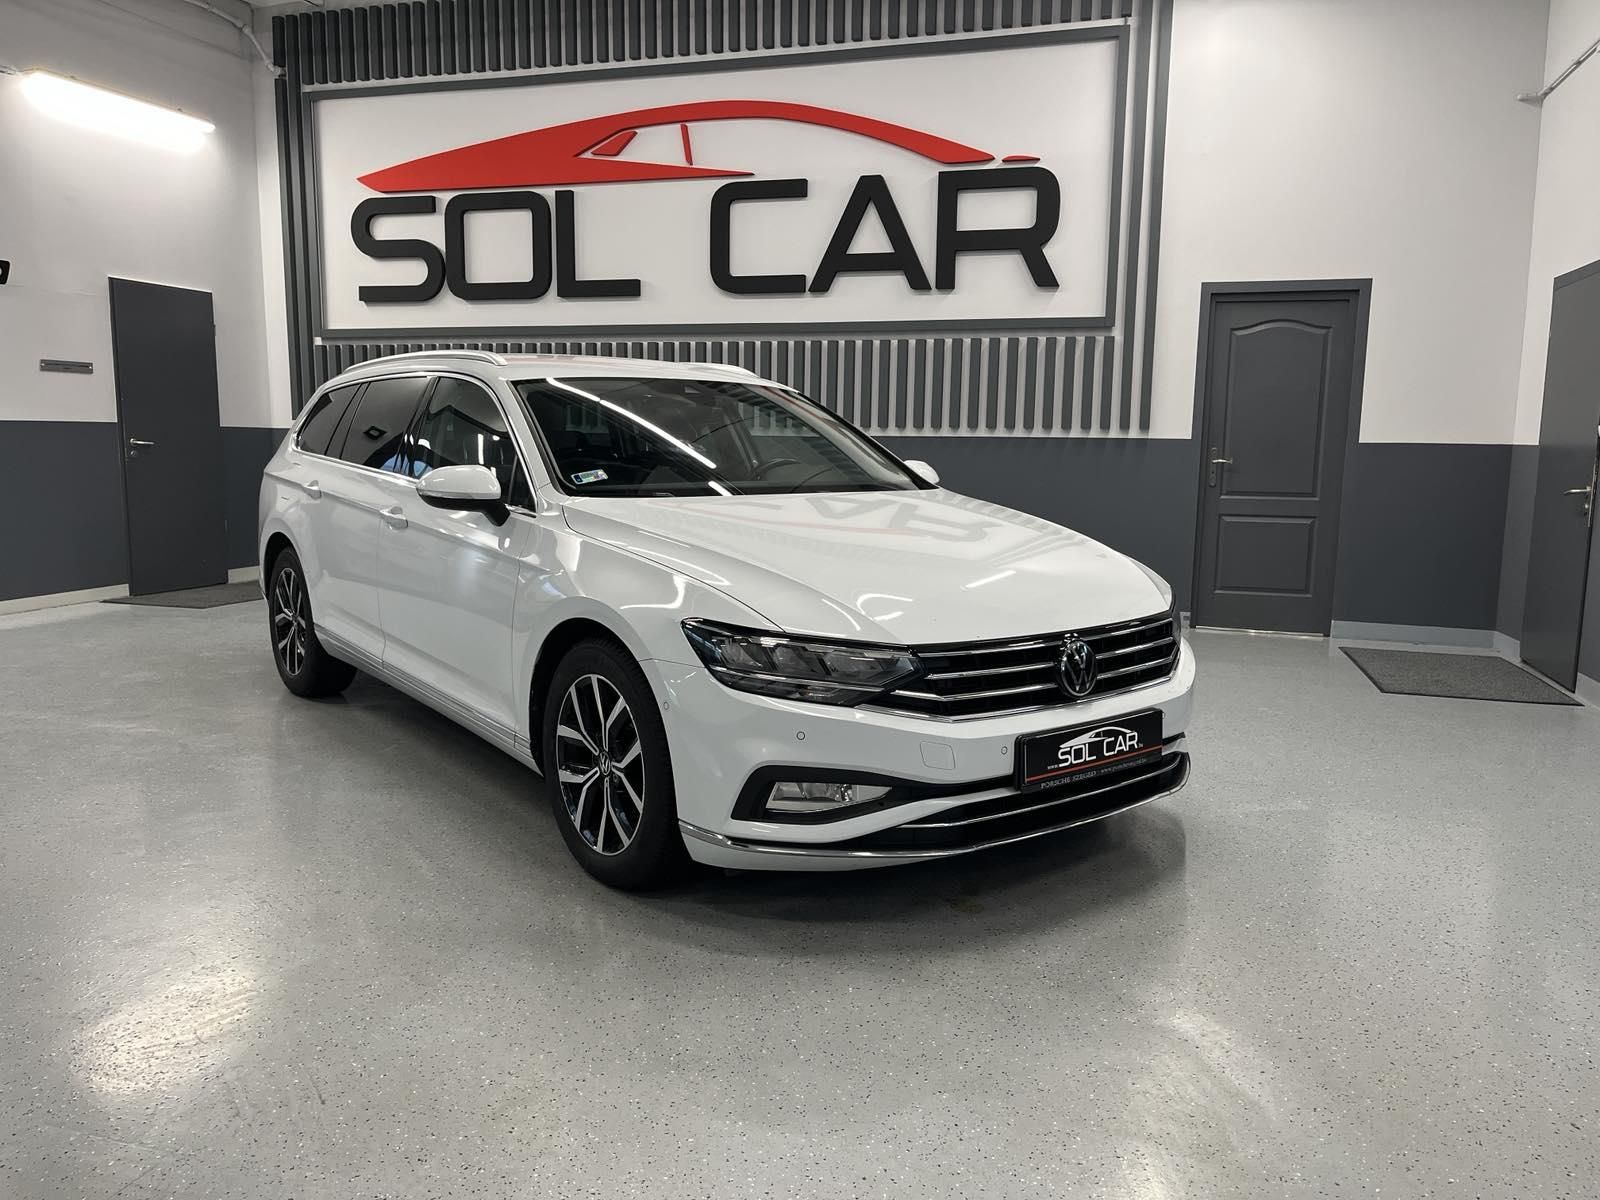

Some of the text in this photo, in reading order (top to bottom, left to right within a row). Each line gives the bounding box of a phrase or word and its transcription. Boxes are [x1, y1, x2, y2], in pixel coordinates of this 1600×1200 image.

[351, 165, 1061, 303] SOL CAR
[1058, 743, 1097, 768] SOL
[1103, 731, 1138, 756] CAR
